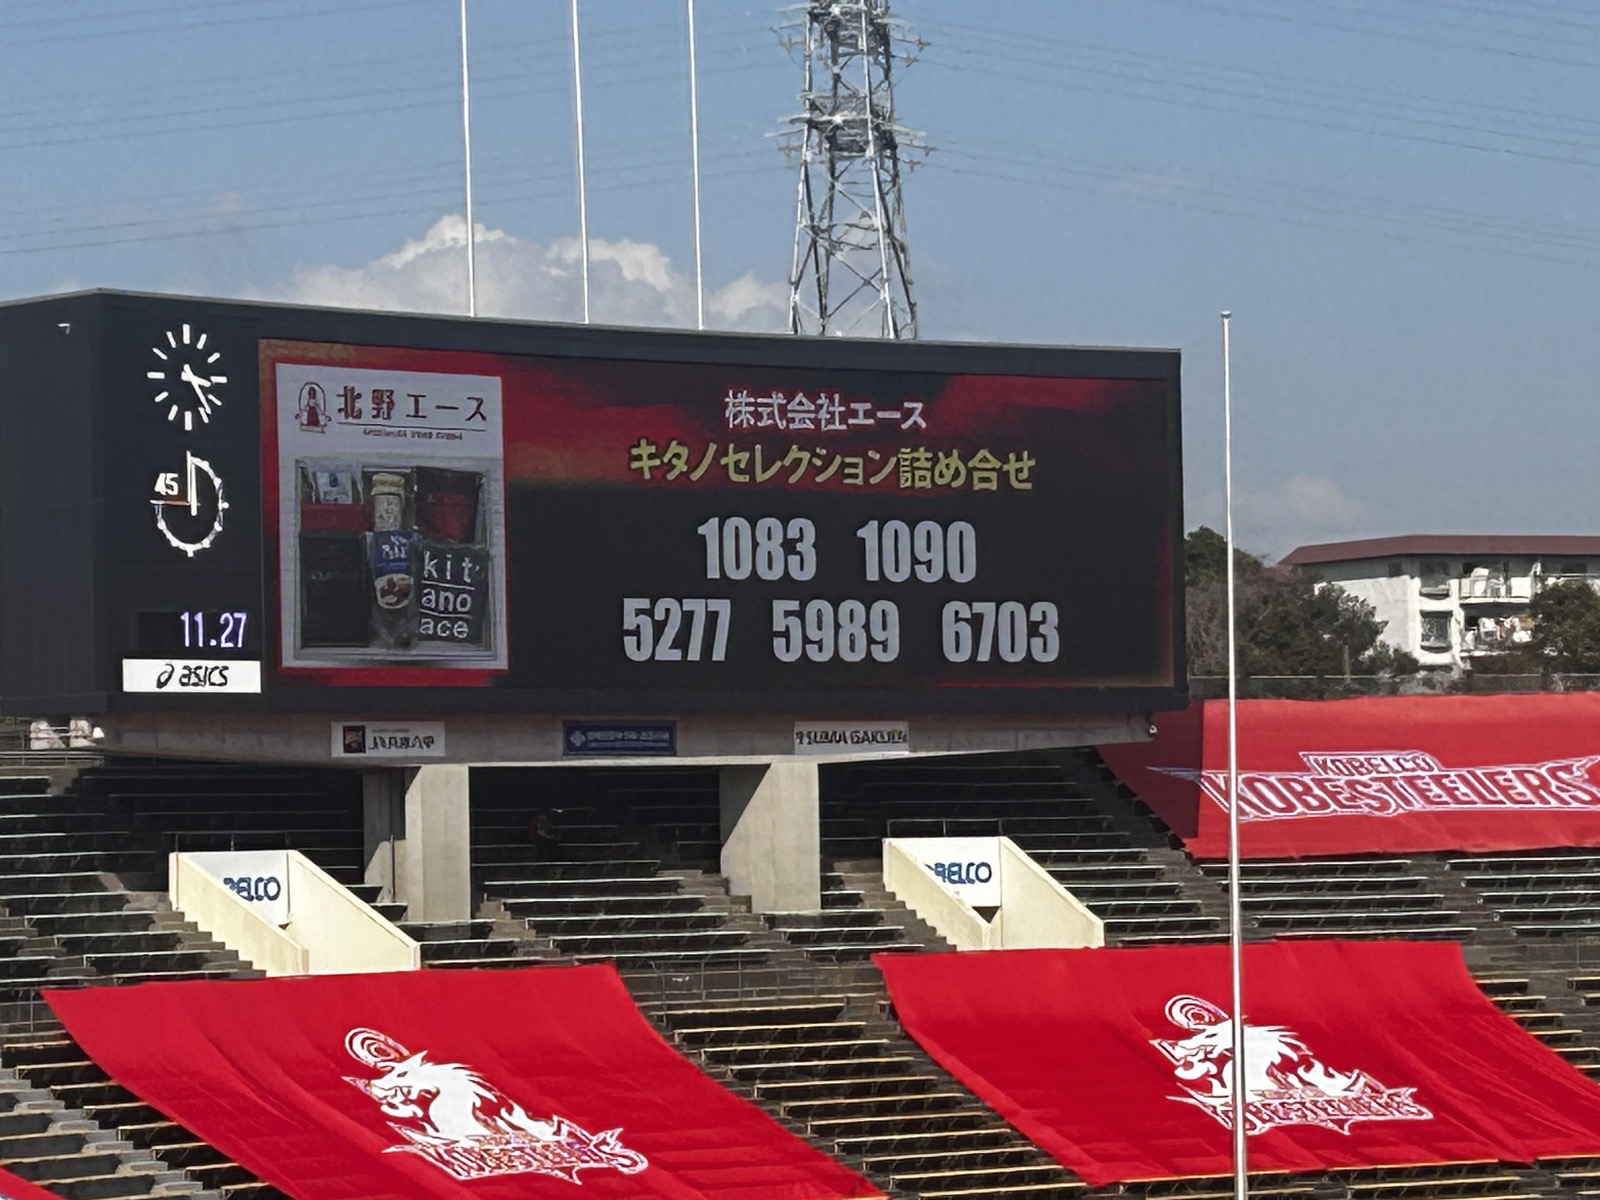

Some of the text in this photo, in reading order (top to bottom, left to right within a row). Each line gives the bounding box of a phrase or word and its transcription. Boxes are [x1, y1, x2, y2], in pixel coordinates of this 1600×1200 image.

[336, 384, 488, 423] 北野エース
[724, 389, 928, 431] 株式会社エース
[629, 437, 1037, 491] キタノセレクション詰め合せ
[154, 472, 179, 496] 45
[697, 516, 977, 583] 1083 1090
[421, 587, 473, 613] ano
[180, 611, 248, 649] 11.27
[419, 617, 470, 639] ace
[622, 597, 1061, 663] 5277 5989 6703
[1314, 755, 1435, 777] KOBELCO
[924, 861, 993, 885] BELCO
